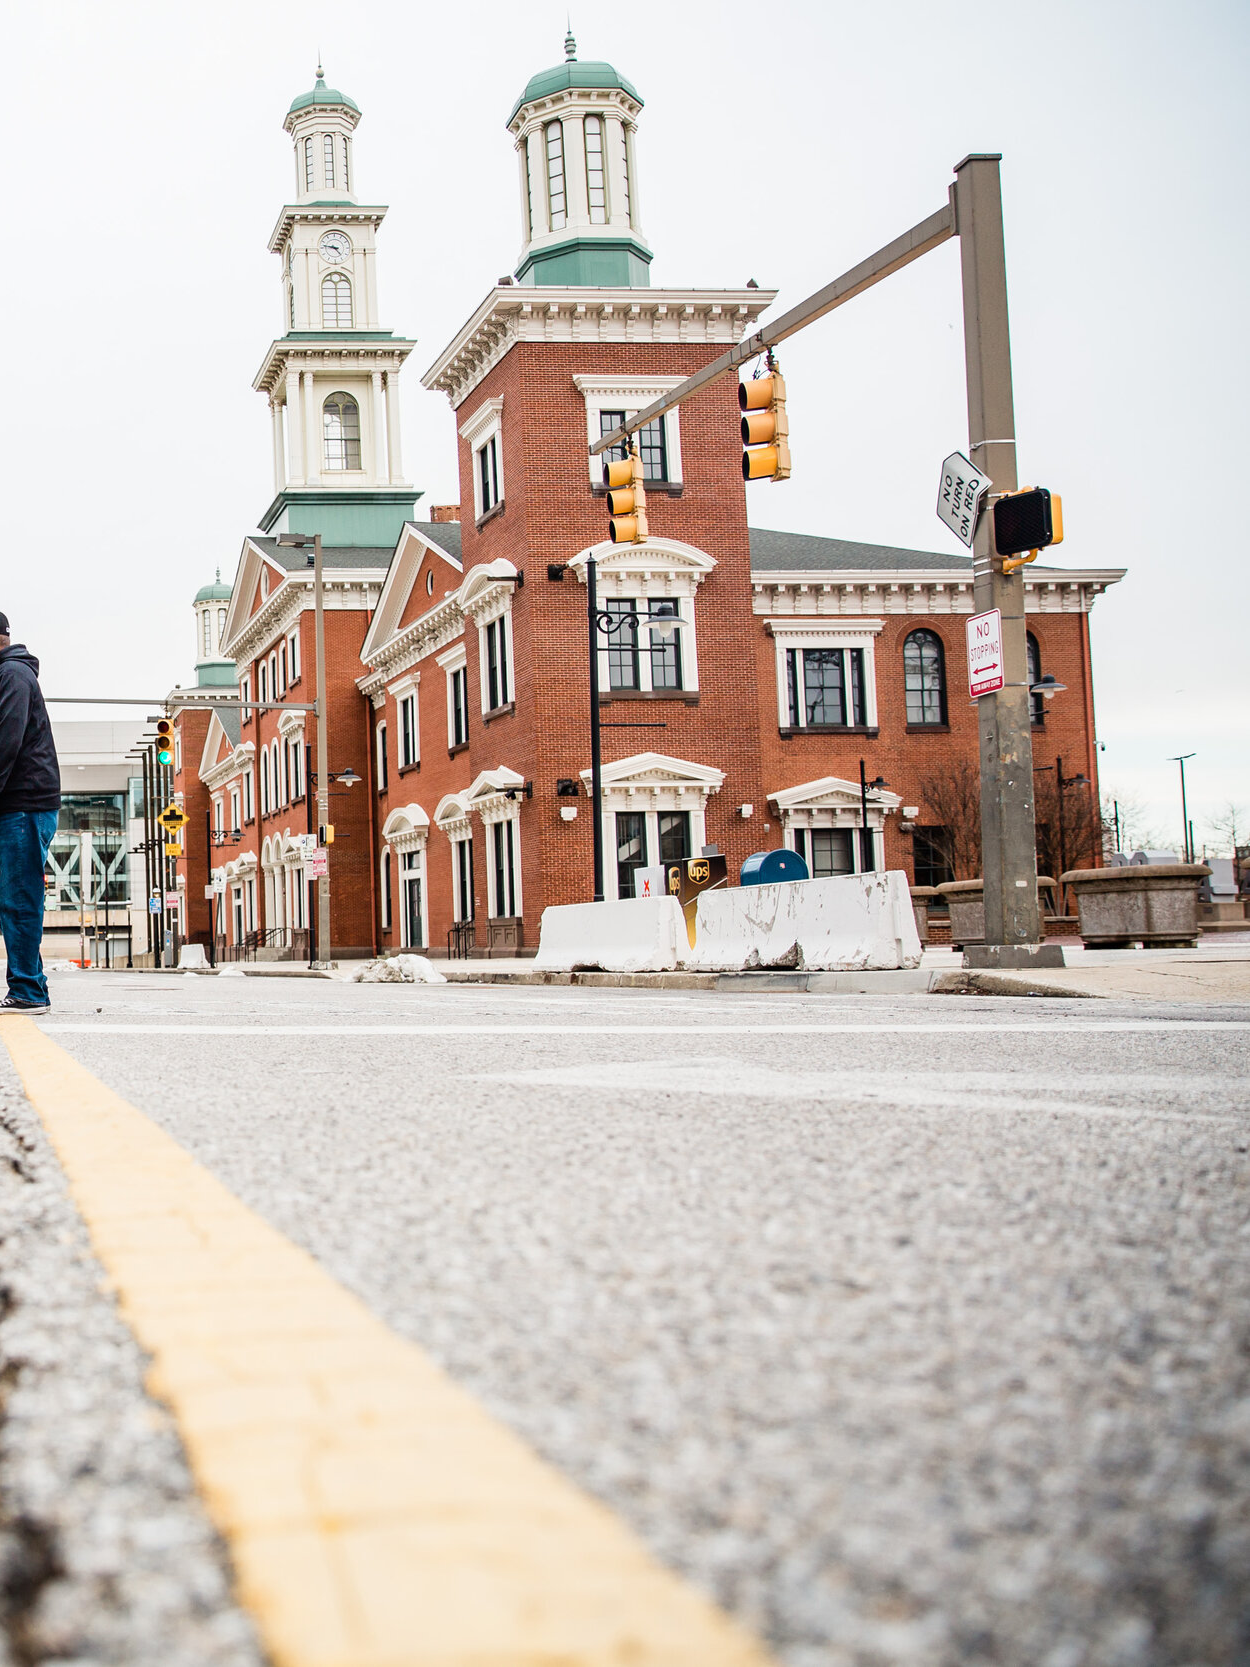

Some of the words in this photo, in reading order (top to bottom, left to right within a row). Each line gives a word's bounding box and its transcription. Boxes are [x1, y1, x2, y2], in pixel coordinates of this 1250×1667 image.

[942, 474, 953, 503] NO
[951, 476, 965, 519] TURN
[963, 478, 980, 512] RED
[960, 514, 970, 538] ON
[976, 621, 990, 640] NO
[969, 640, 999, 662] STOPPING
[990, 677, 1001, 688] ZONE
[690, 866, 708, 881] ups
[669, 877, 681, 895] ups
